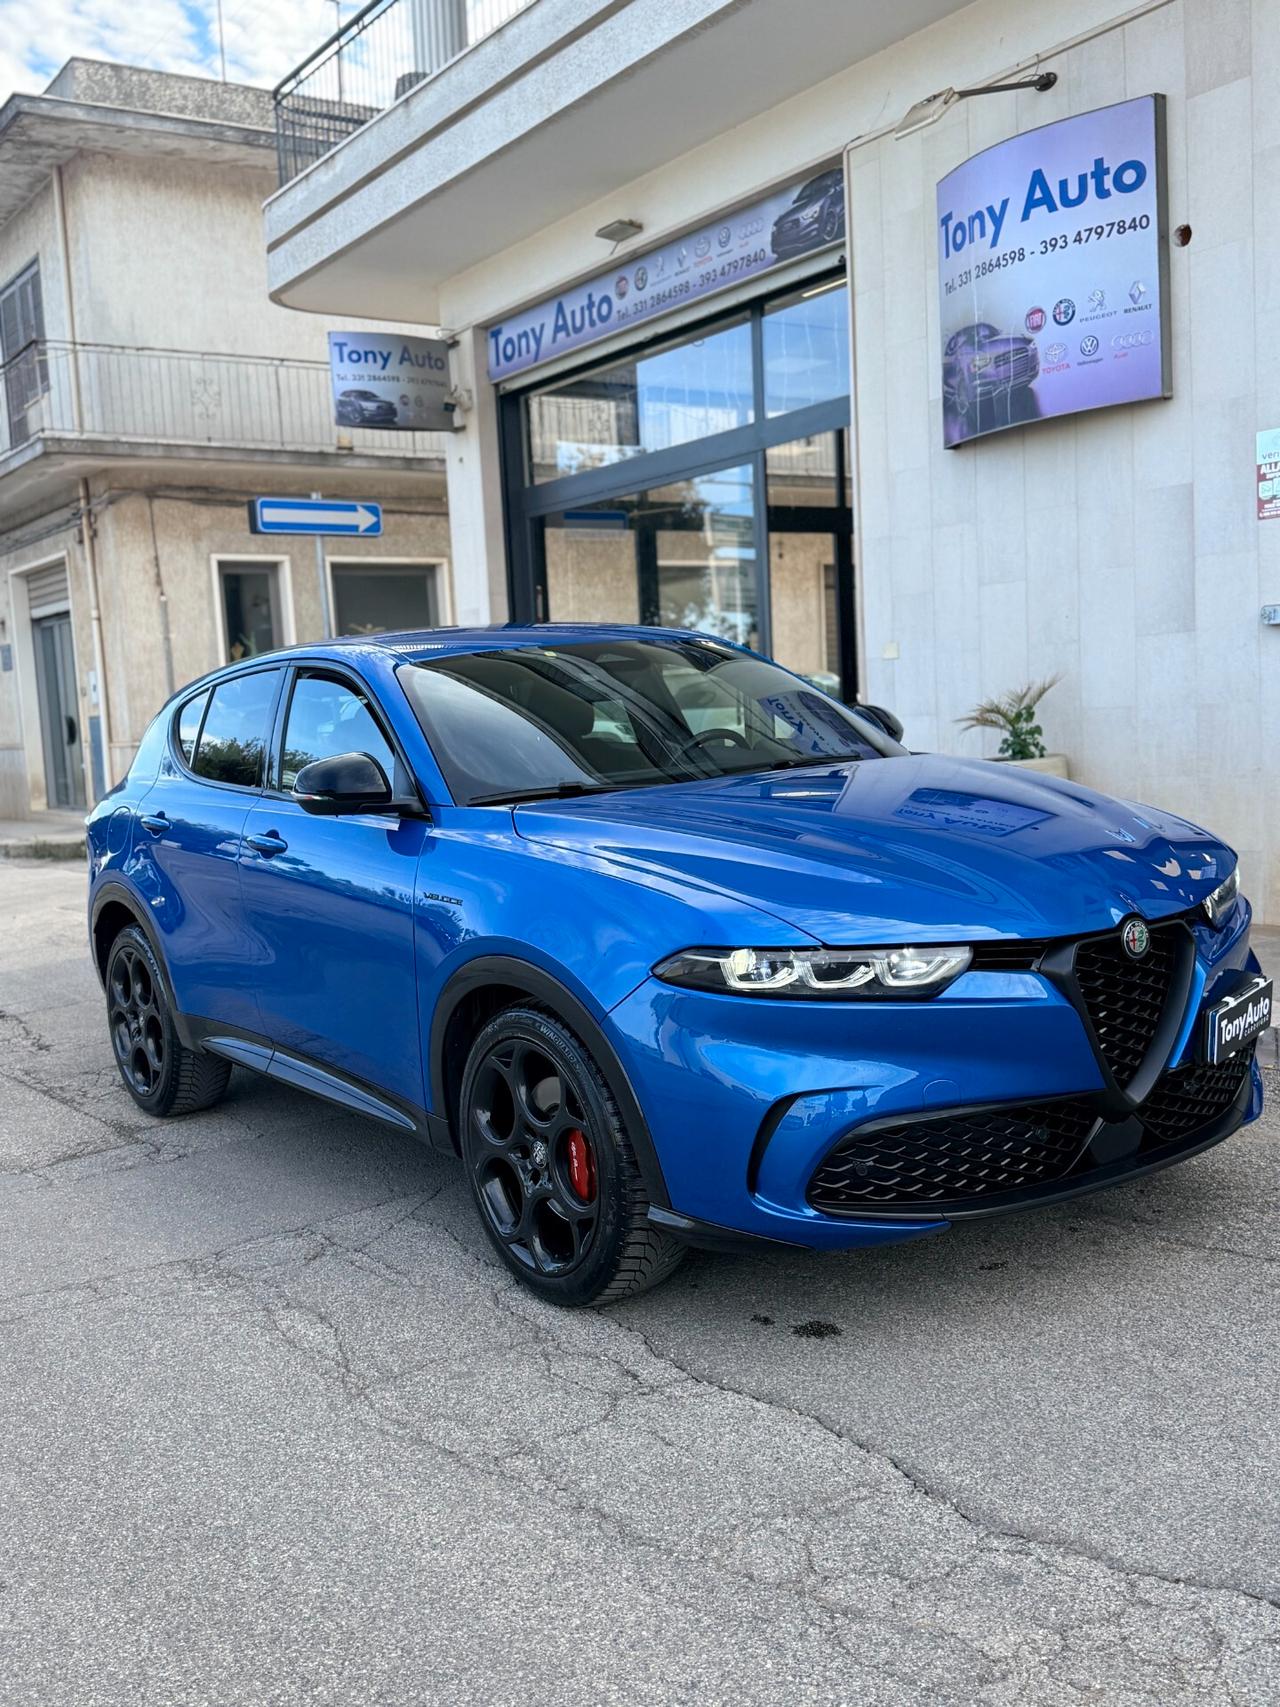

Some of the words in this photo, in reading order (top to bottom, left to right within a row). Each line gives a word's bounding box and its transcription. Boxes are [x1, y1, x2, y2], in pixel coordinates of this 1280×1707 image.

[940, 197, 1010, 260] Tony
[1020, 156, 1148, 223] Auto
[958, 270, 973, 289] 331
[974, 247, 1026, 280] 2864598
[1039, 234, 1069, 256] 393
[1072, 214, 1151, 246] 4797840
[633, 300, 648, 315] 331
[650, 280, 691, 308] 2864598
[699, 269, 717, 289] 393
[718, 247, 767, 278] 4797840
[489, 323, 545, 368] Tony
[551, 292, 613, 344] Auto
[1079, 310, 1118, 323] PEUGEOT
[1123, 304, 1152, 315] RENAULT
[333, 342, 392, 371] Tony
[398, 345, 446, 371] Auto
[1042, 363, 1071, 374] TOYOTA
